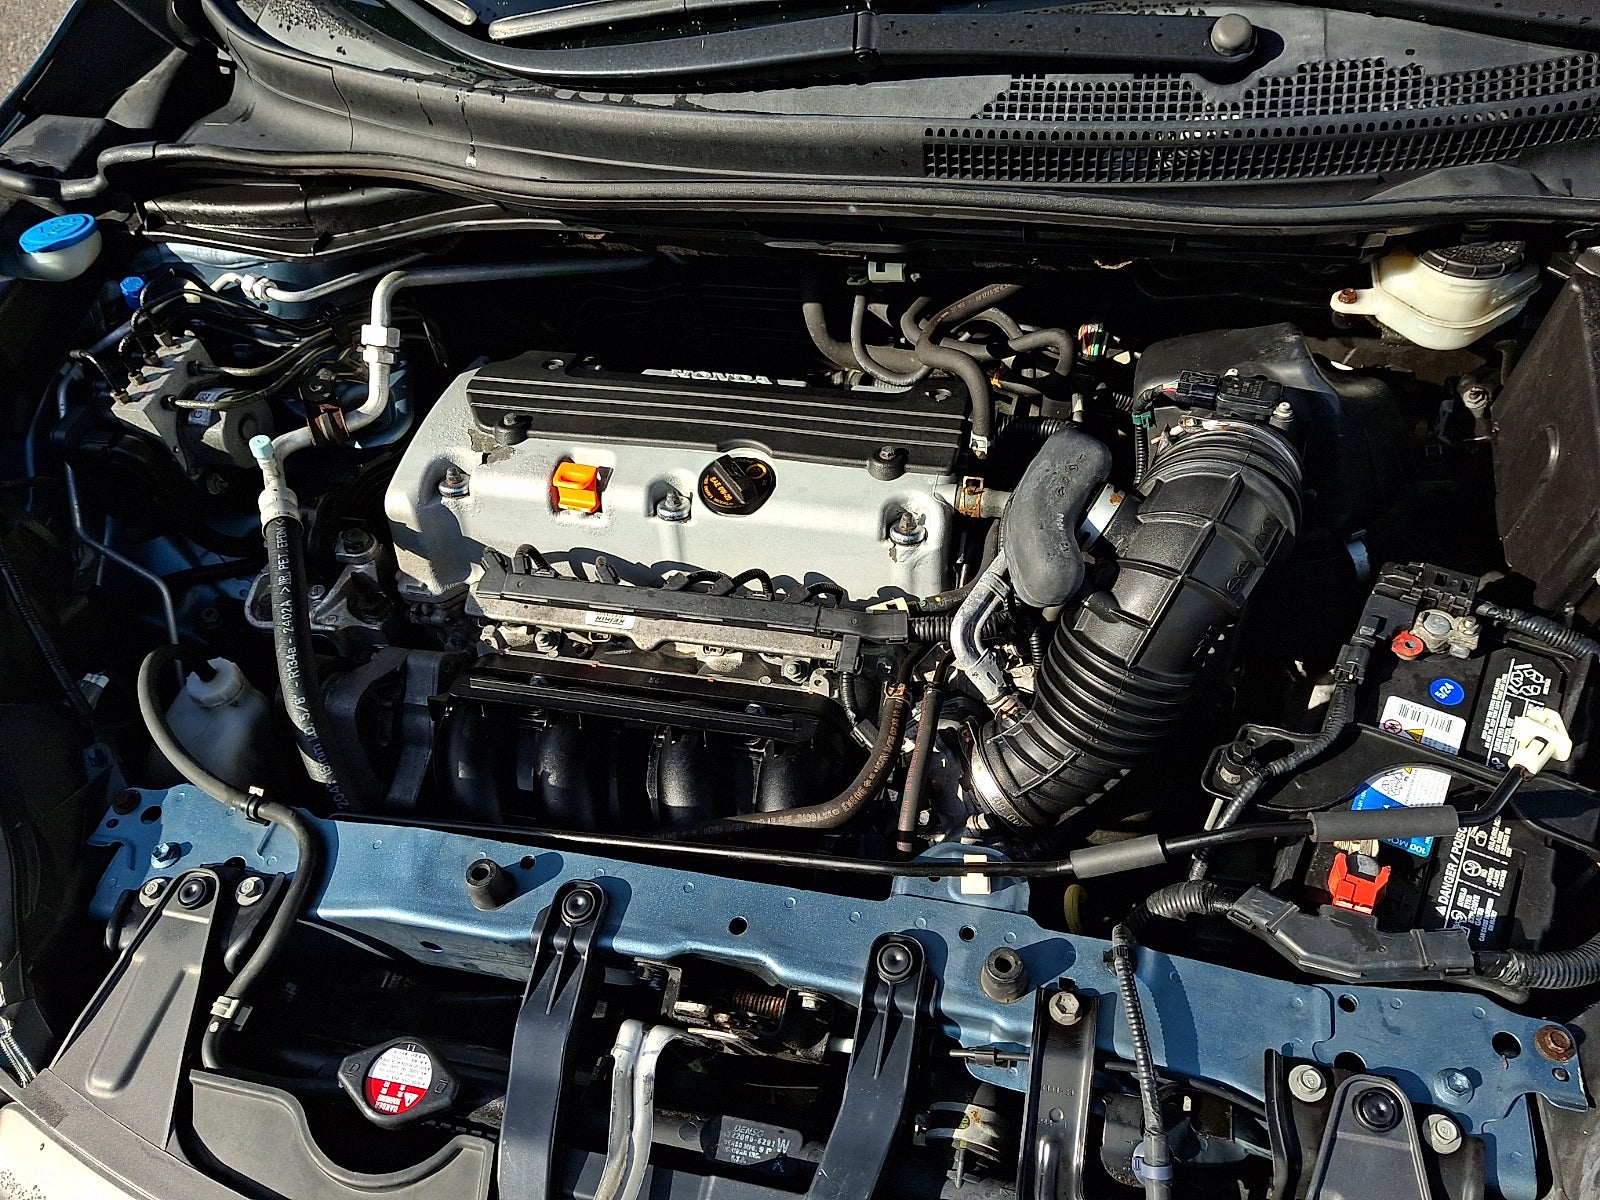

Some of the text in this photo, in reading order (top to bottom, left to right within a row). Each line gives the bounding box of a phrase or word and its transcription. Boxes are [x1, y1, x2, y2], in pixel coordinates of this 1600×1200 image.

[669, 368, 773, 385] HONDA
[287, 647, 299, 679] R134a
[1434, 681, 1455, 701] 5/24
[1409, 843, 1426, 854] 100
[1437, 827, 1467, 905] DANGER/POISO
